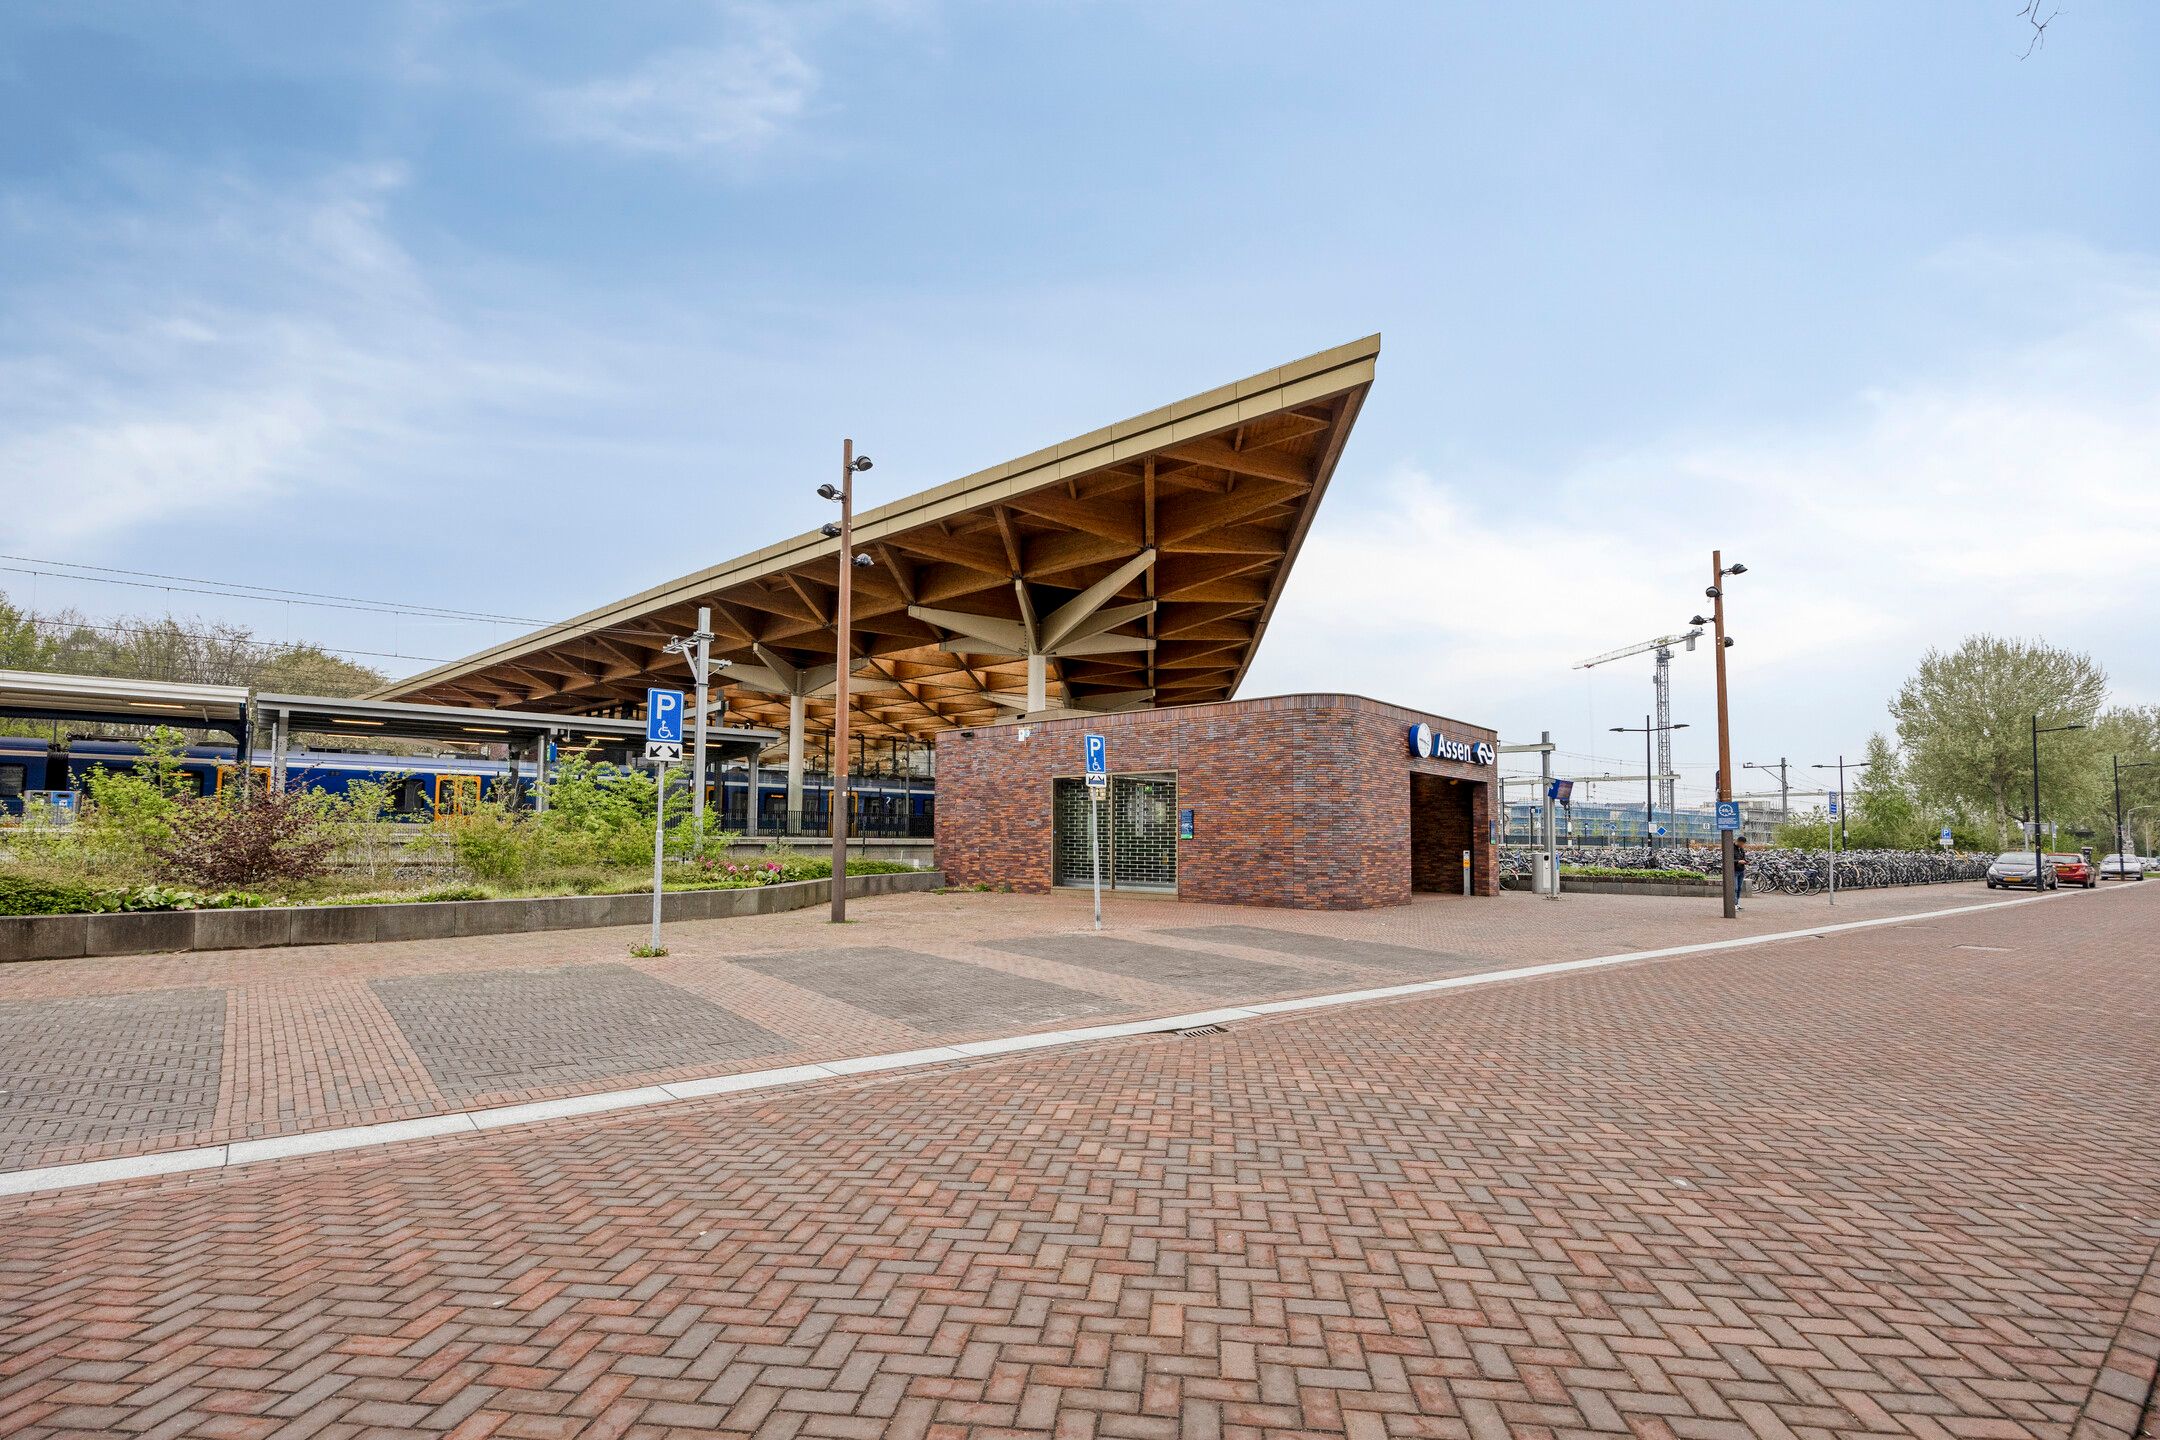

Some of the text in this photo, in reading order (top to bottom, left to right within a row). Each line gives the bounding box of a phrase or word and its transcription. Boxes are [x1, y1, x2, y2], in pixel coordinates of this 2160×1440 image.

[656, 694, 676, 720] P
[1090, 738, 1101, 757] P
[1437, 733, 1471, 762] Assen
